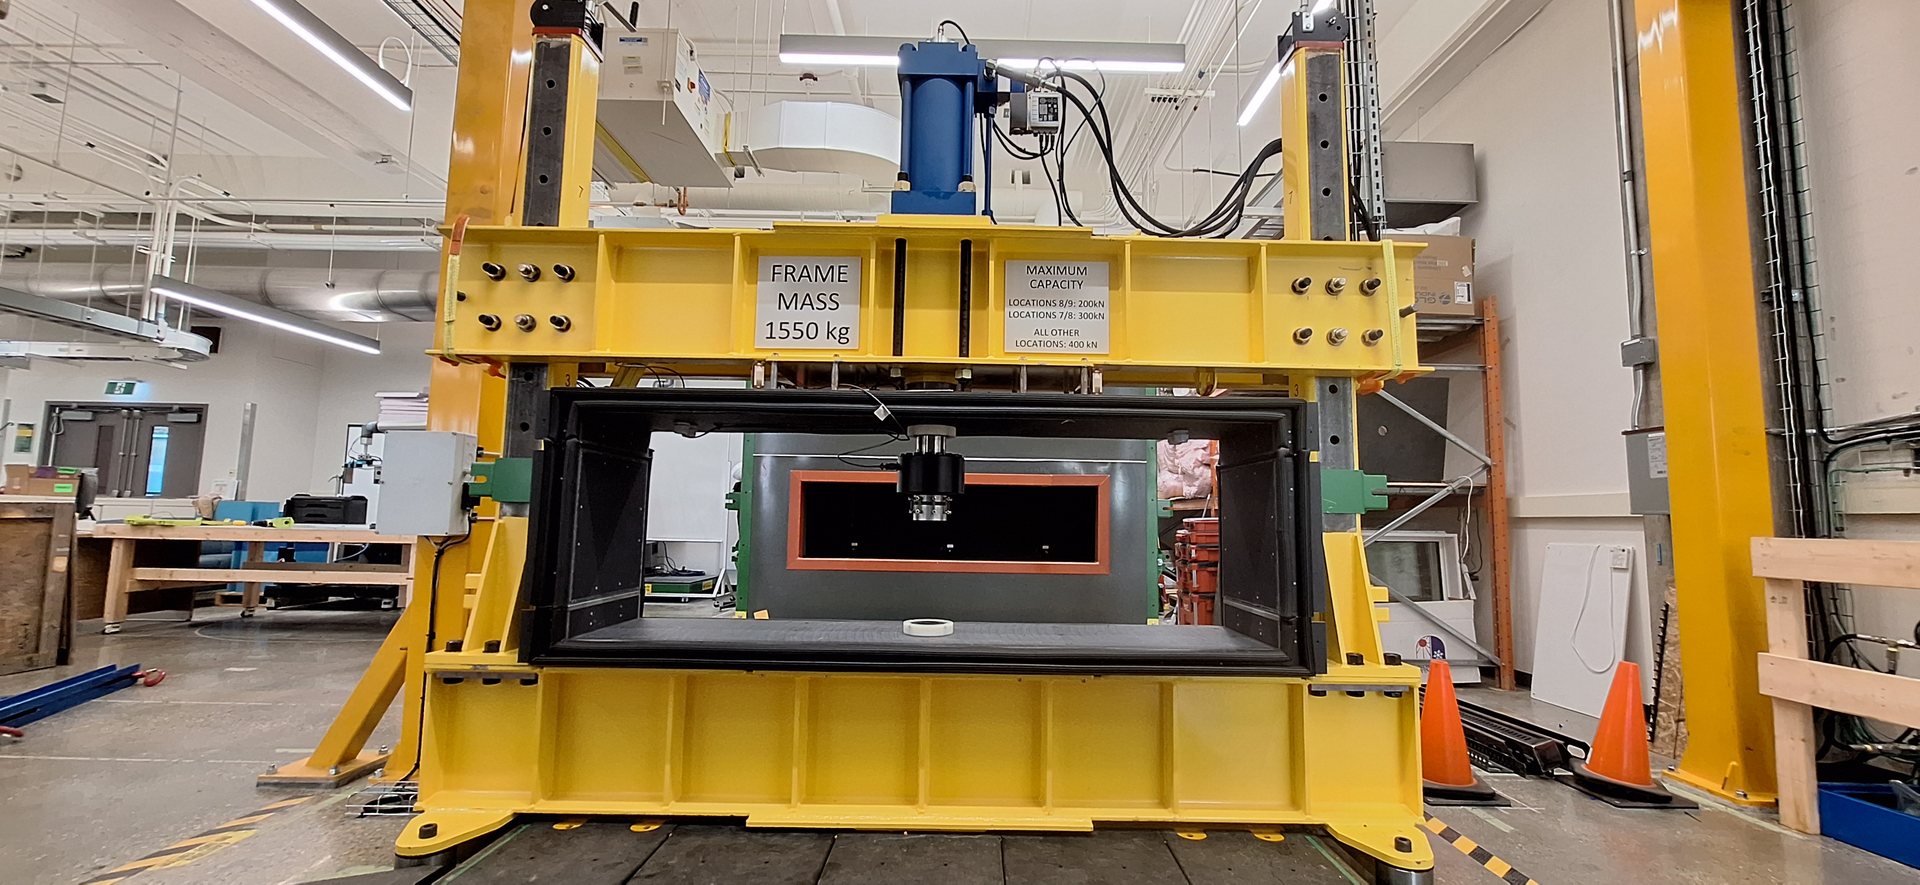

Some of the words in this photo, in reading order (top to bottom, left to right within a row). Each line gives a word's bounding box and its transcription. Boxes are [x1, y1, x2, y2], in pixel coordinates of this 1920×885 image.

[771, 264, 849, 283] FRAME
[1026, 265, 1088, 276] MAXIMUM
[1030, 279, 1084, 290] CAPACITY
[777, 292, 841, 311] MASS
[1008, 299, 1057, 308] LOCATIONS
[1058, 300, 1076, 309] 8/9:
[1078, 300, 1105, 309] 200kN
[1008, 311, 1057, 319] LOCATIONS
[1059, 311, 1076, 320] 7/8:
[1078, 312, 1105, 320] 300kN
[765, 321, 819, 341] 1550
[826, 320, 850, 345] kg
[1033, 328, 1049, 337] ALL
[1050, 328, 1080, 337] OTHER
[1015, 340, 1067, 349] LOCATIONS:
[1068, 340, 1085, 349] 400
[1086, 341, 1098, 349] kN
[565, 374, 571, 387] 3
[1294, 383, 1299, 397] 3
